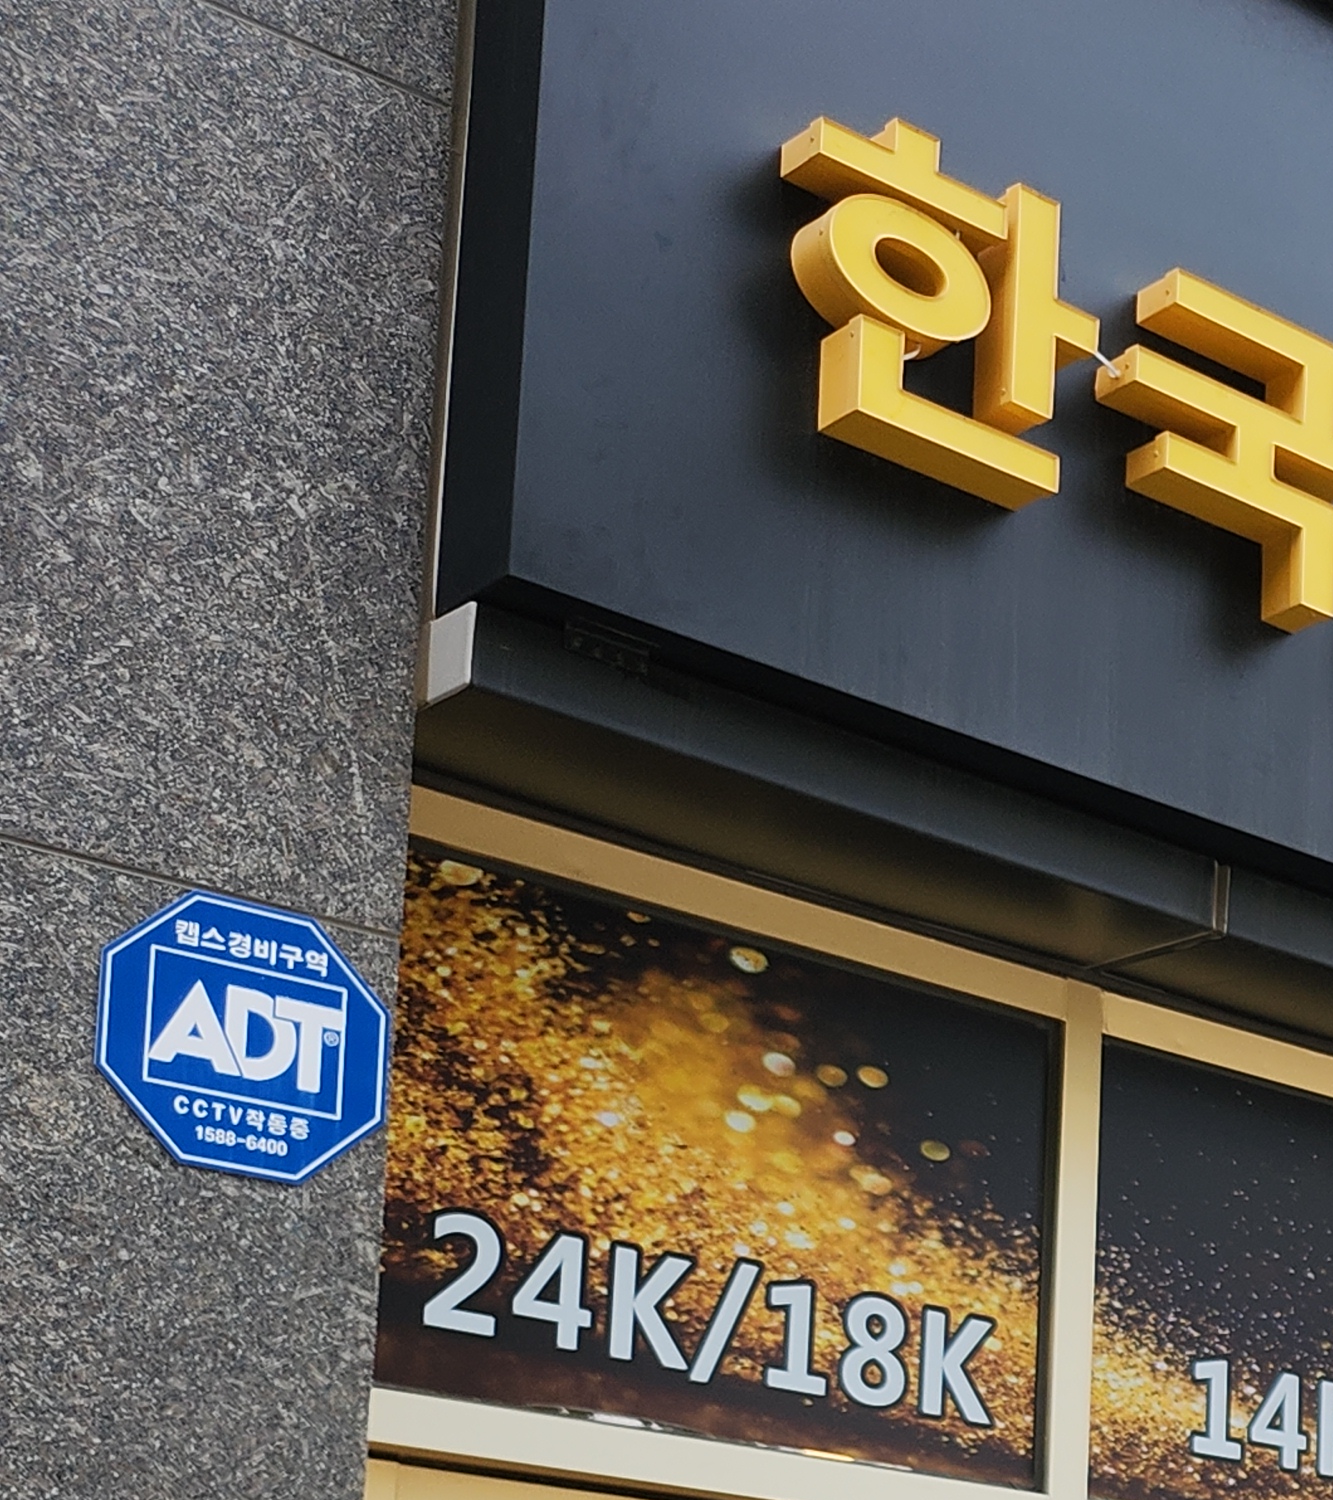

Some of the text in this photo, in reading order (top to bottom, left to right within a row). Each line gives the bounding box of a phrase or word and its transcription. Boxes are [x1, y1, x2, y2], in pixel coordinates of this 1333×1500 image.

[174, 918, 330, 978] 캡스경비구역
[148, 980, 345, 1094] ADT
[194, 1124, 289, 1158] 1588-6400
[422, 1211, 996, 1425] 24K/18K
